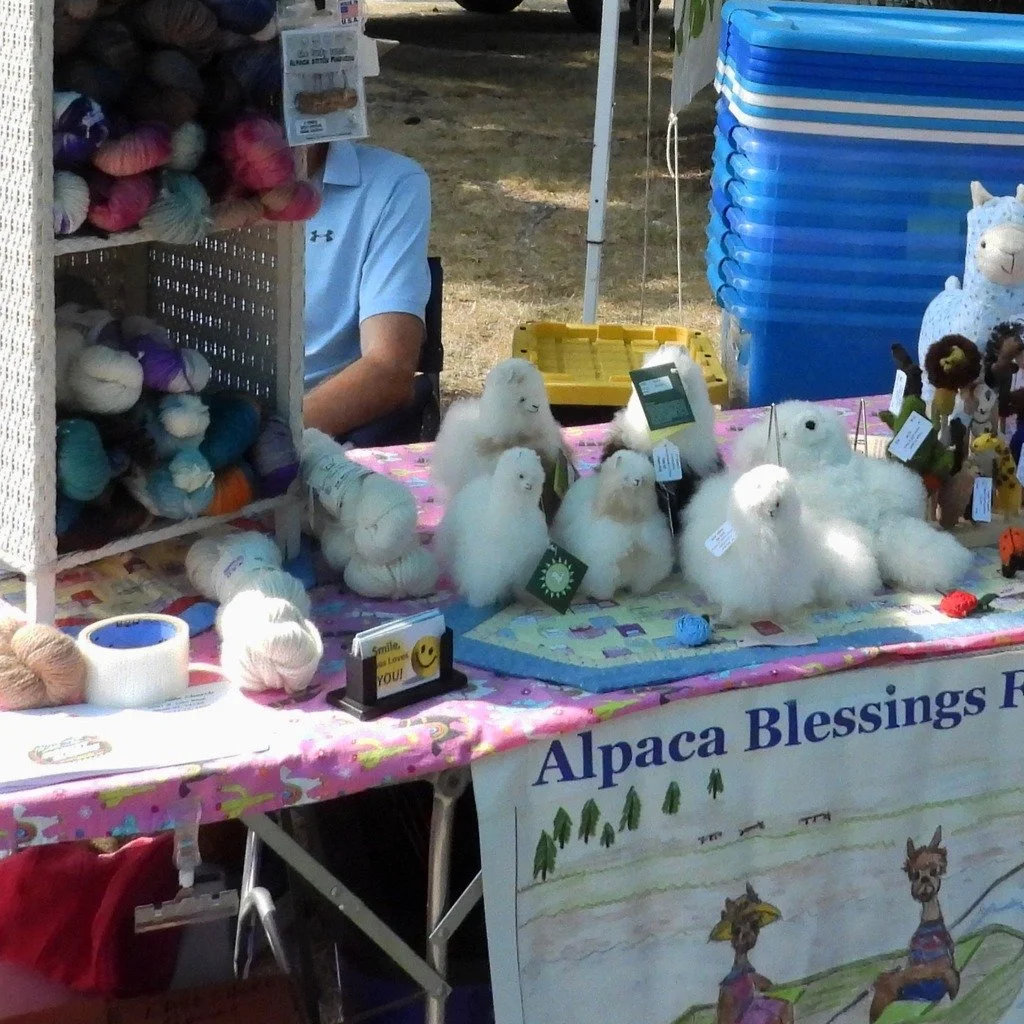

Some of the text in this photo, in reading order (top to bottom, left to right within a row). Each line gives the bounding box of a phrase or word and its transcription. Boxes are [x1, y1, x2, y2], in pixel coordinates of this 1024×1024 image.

[371, 640, 401, 655] Smile,
[377, 667, 403, 687] YOU!
[531, 725, 729, 791] Alpaca
[745, 682, 987, 754] Blessings
